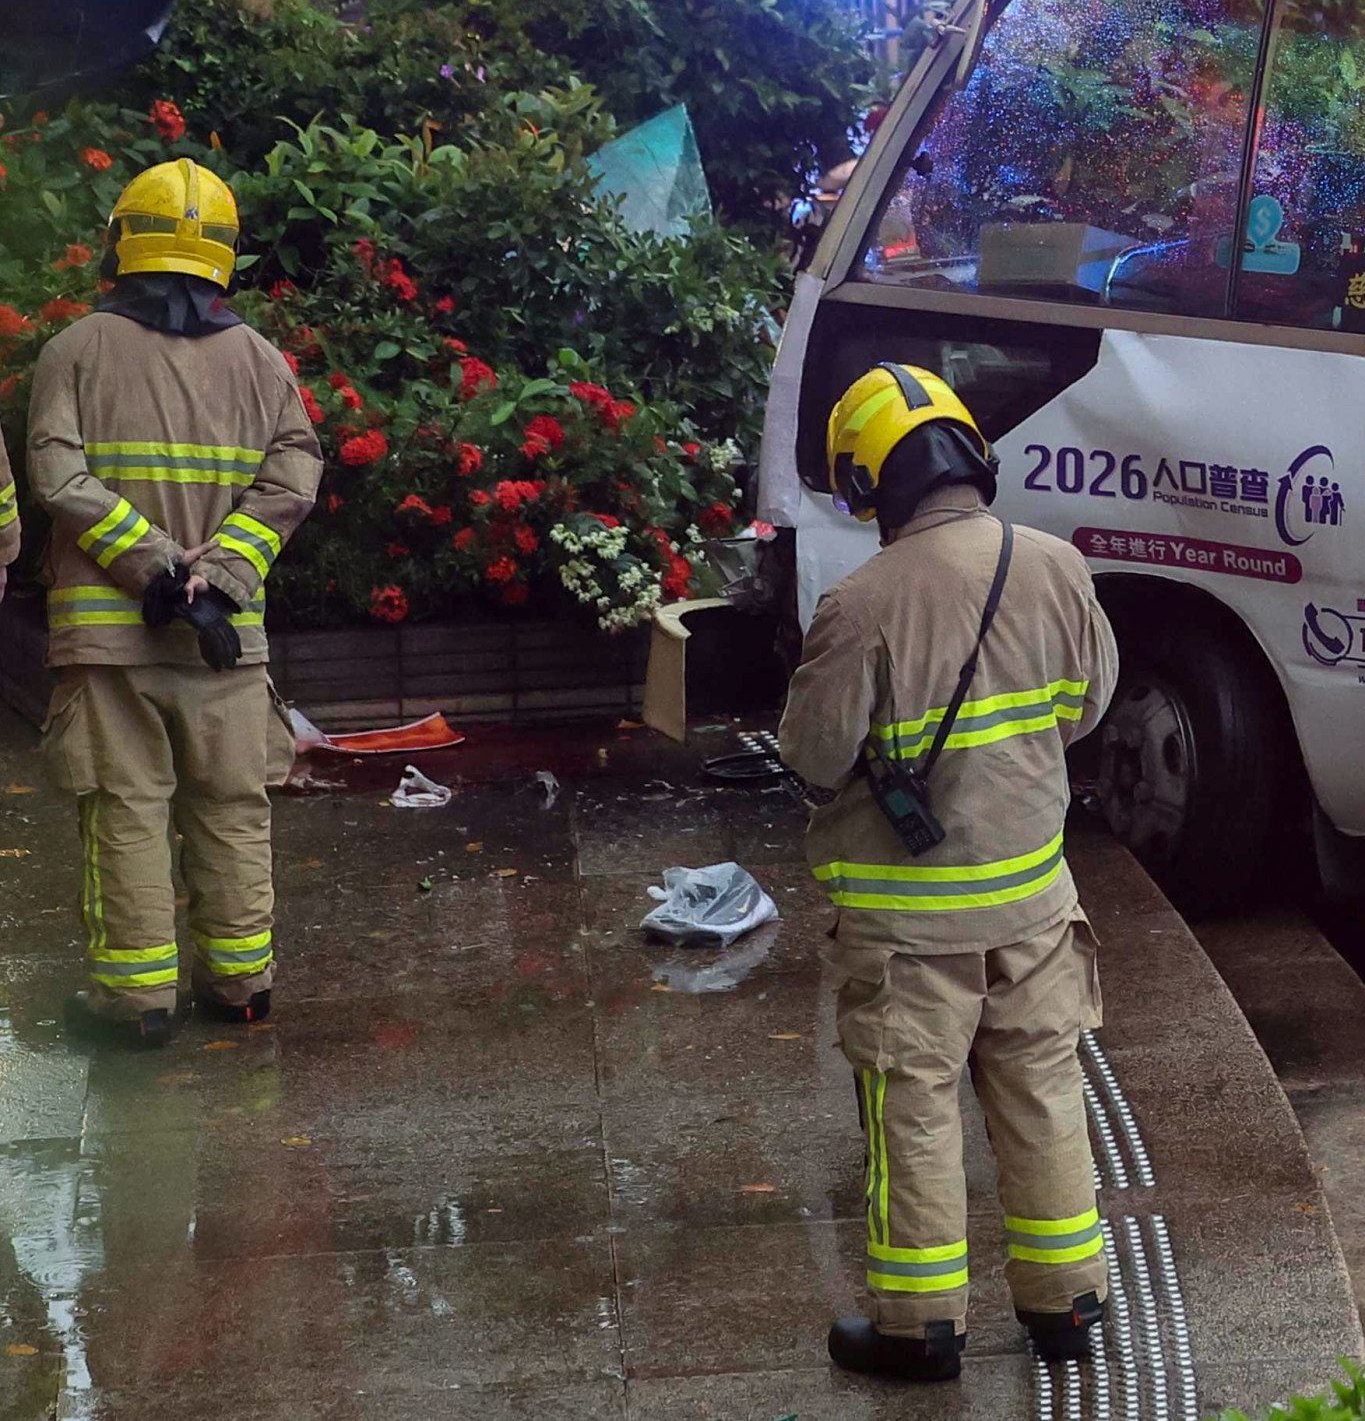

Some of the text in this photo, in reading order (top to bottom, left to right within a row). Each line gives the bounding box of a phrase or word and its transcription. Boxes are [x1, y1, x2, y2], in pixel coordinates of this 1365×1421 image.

[1023, 444, 1269, 504] 2026 人口普查
[1152, 490, 1269, 518] Population Census
[1089, 533, 1286, 577] 全年進行 Year Round
